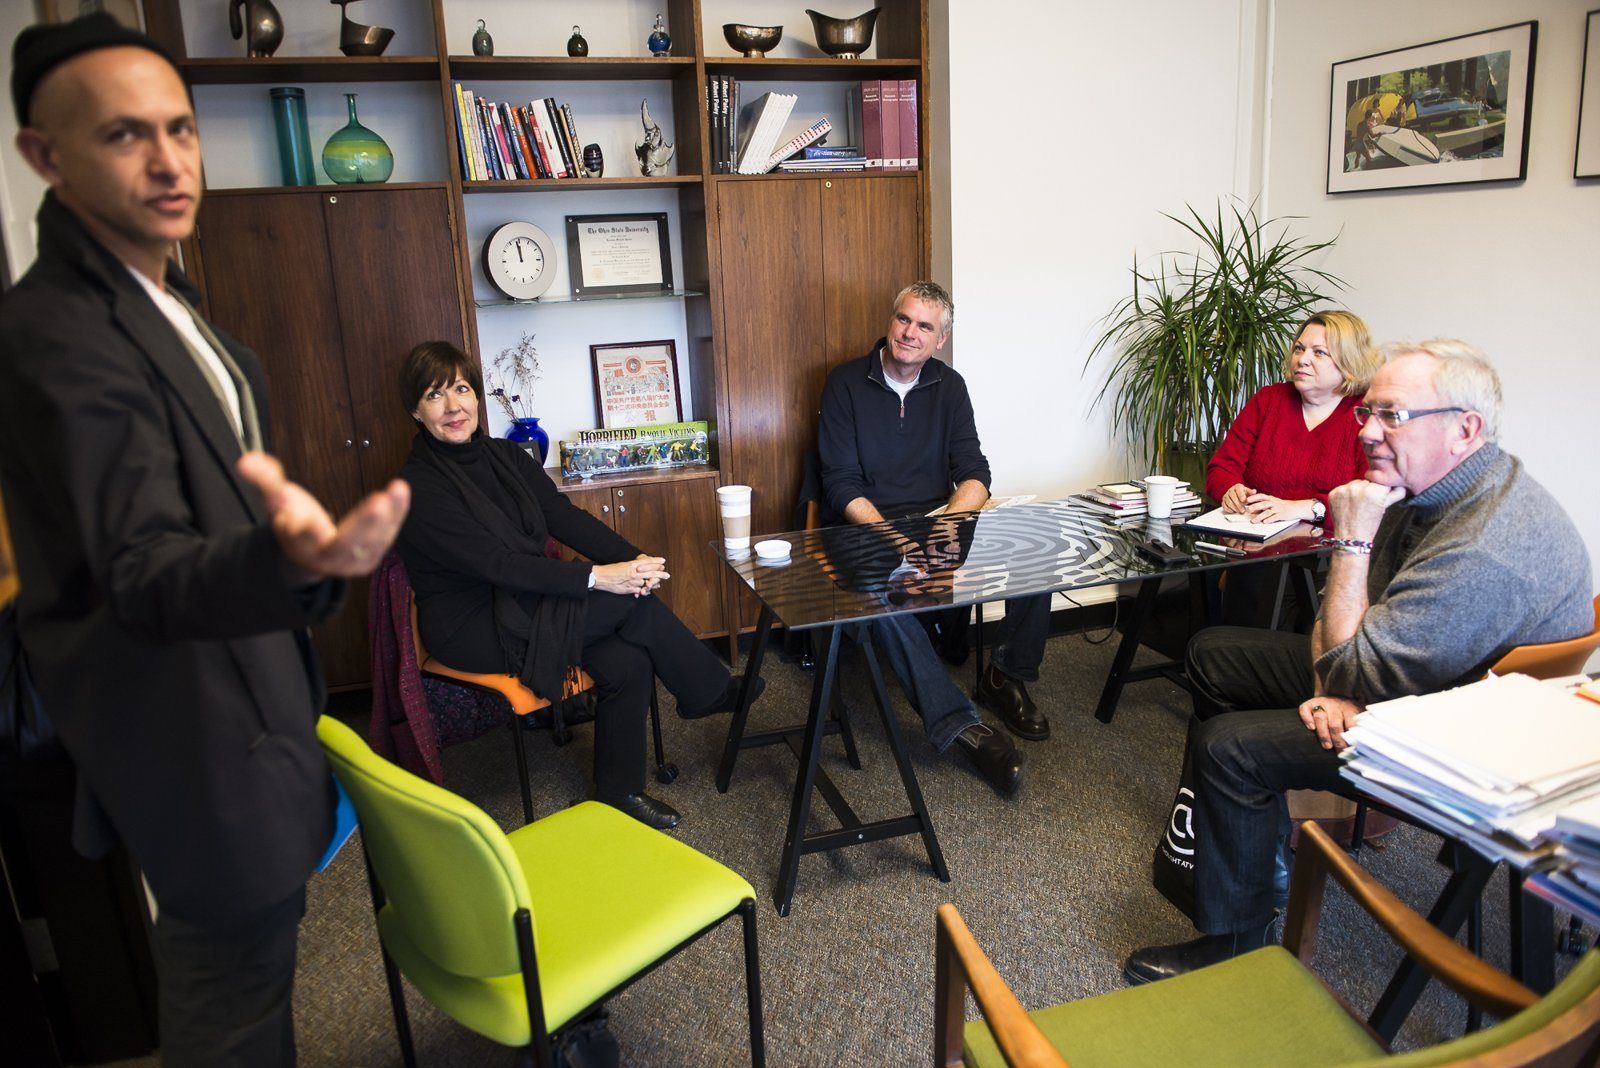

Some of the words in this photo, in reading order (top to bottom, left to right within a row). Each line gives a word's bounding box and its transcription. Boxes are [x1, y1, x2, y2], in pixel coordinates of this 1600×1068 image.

[587, 227, 597, 235] The
[625, 226, 650, 234] University
[579, 429, 637, 443] HORRIFIED
[669, 427, 696, 436] VICTIMS
